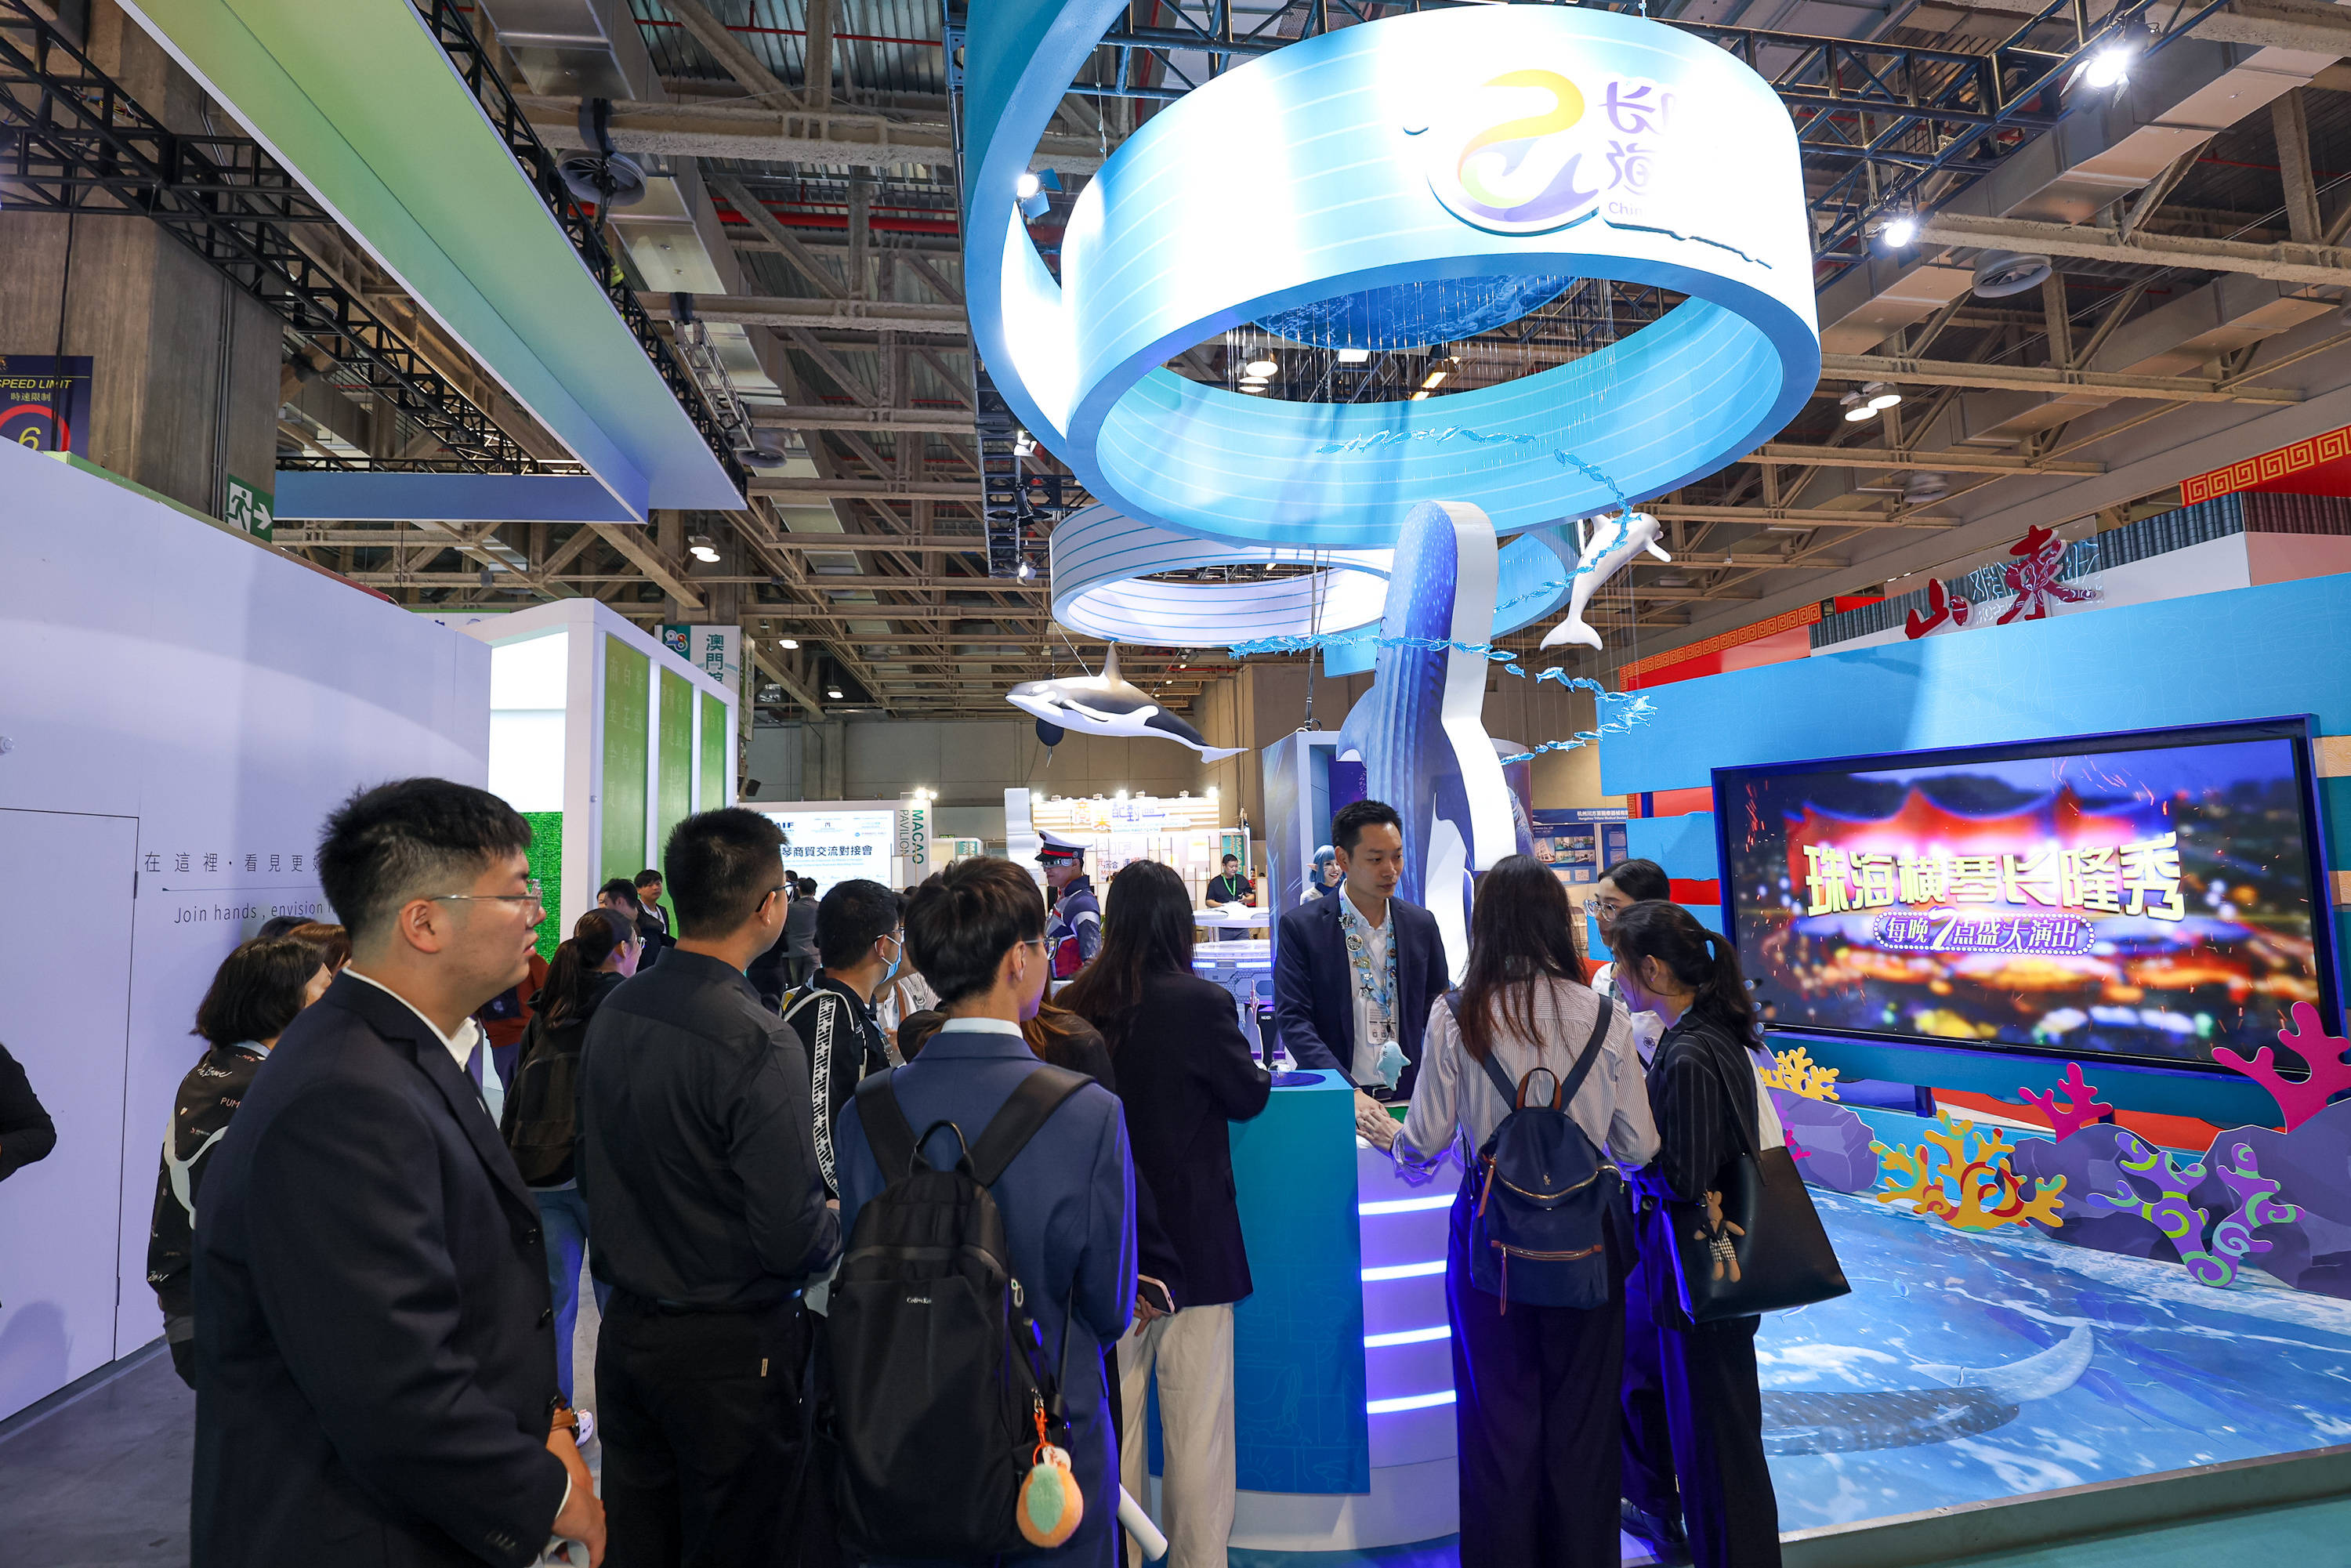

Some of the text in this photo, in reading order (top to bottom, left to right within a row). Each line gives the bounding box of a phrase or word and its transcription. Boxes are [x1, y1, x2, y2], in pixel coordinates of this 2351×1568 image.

[0, 378, 36, 389] PEED
[18, 426, 42, 451] 6
[911, 809, 924, 864] MACAO
[1802, 831, 2186, 922] 珠海横琴长隆秀
[174, 907, 207, 924] Join
[271, 901, 324, 917] envision
[1886, 906, 2079, 951] 每晚7点盛大演出
